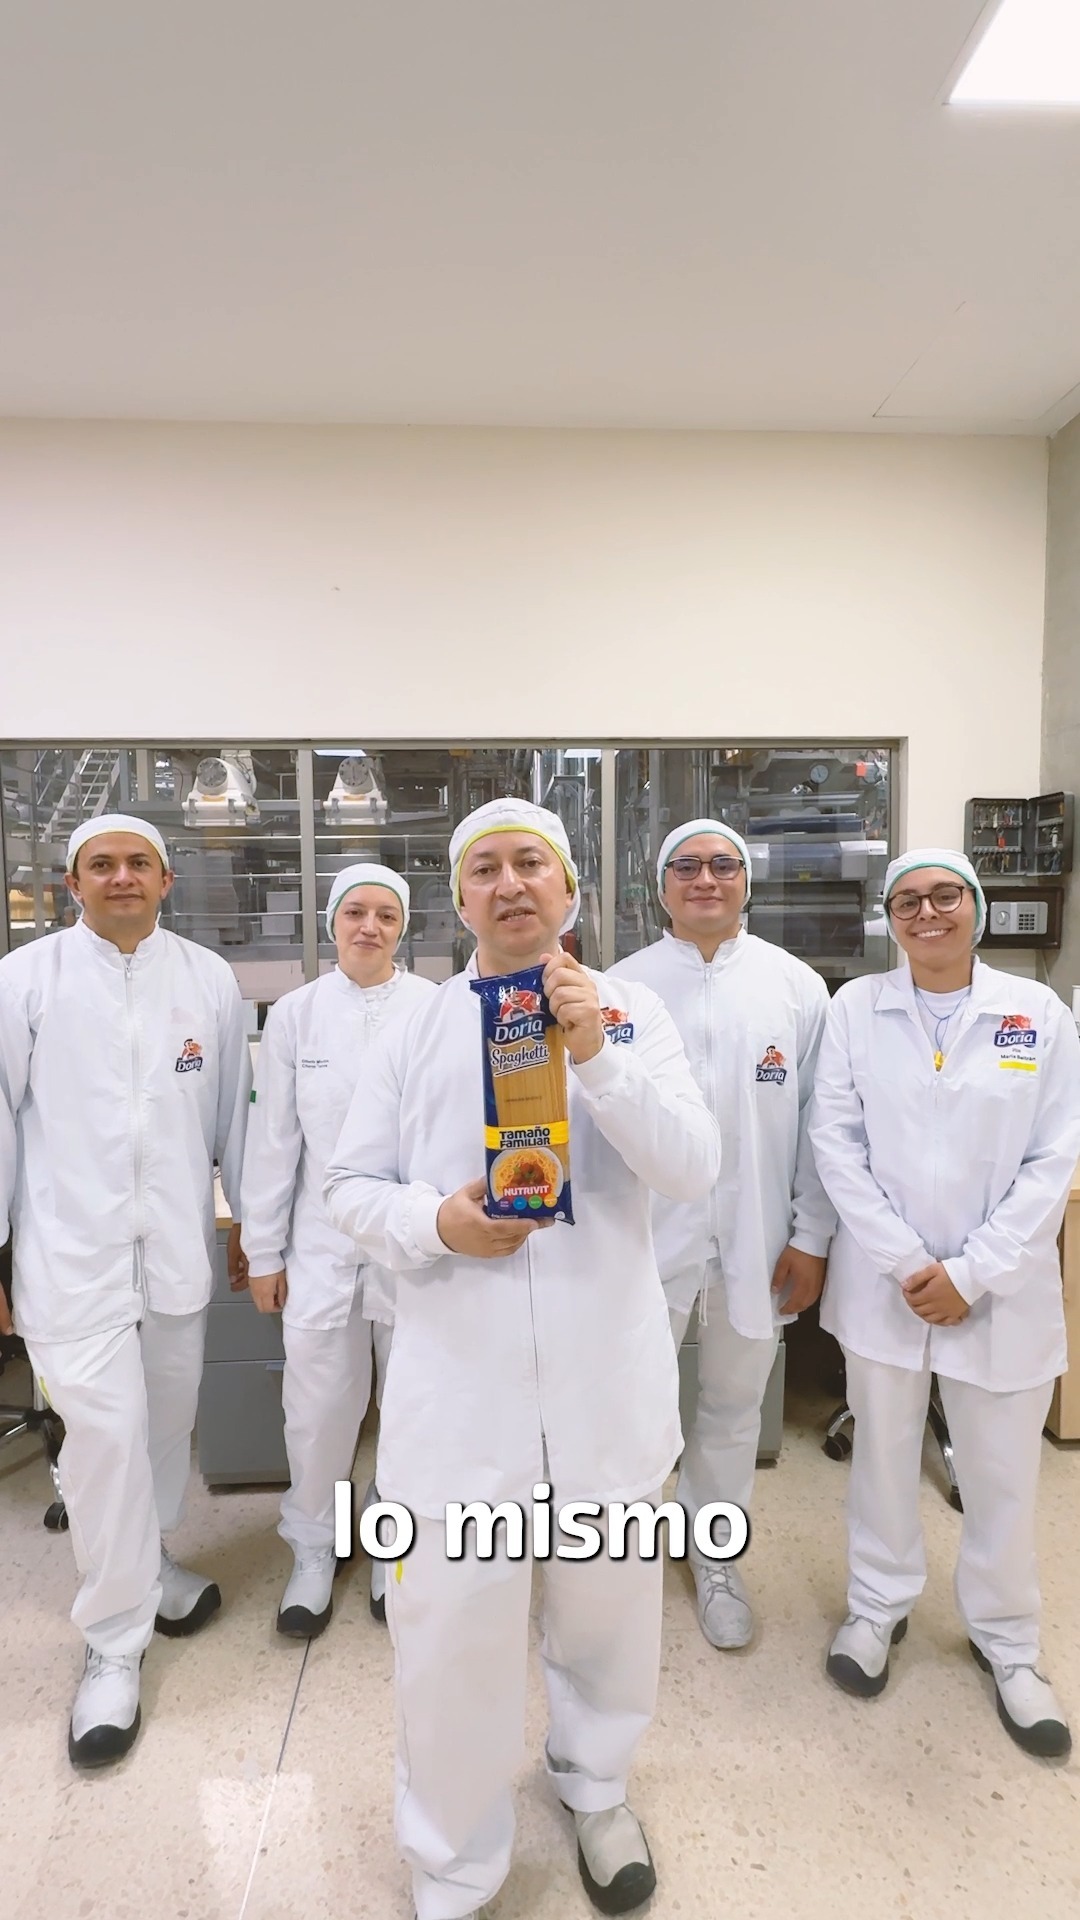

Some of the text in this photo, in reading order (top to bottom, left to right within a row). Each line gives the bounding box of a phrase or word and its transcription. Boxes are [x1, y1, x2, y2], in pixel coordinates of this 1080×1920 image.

[495, 1016, 543, 1042] Doria
[997, 1032, 1034, 1046] Doria
[491, 1044, 549, 1070] Spaghetti
[177, 1060, 201, 1071] Doria
[756, 1070, 785, 1081] Doria
[499, 1125, 551, 1140] Tamaño
[504, 1185, 550, 1197] NUTRIVIT
